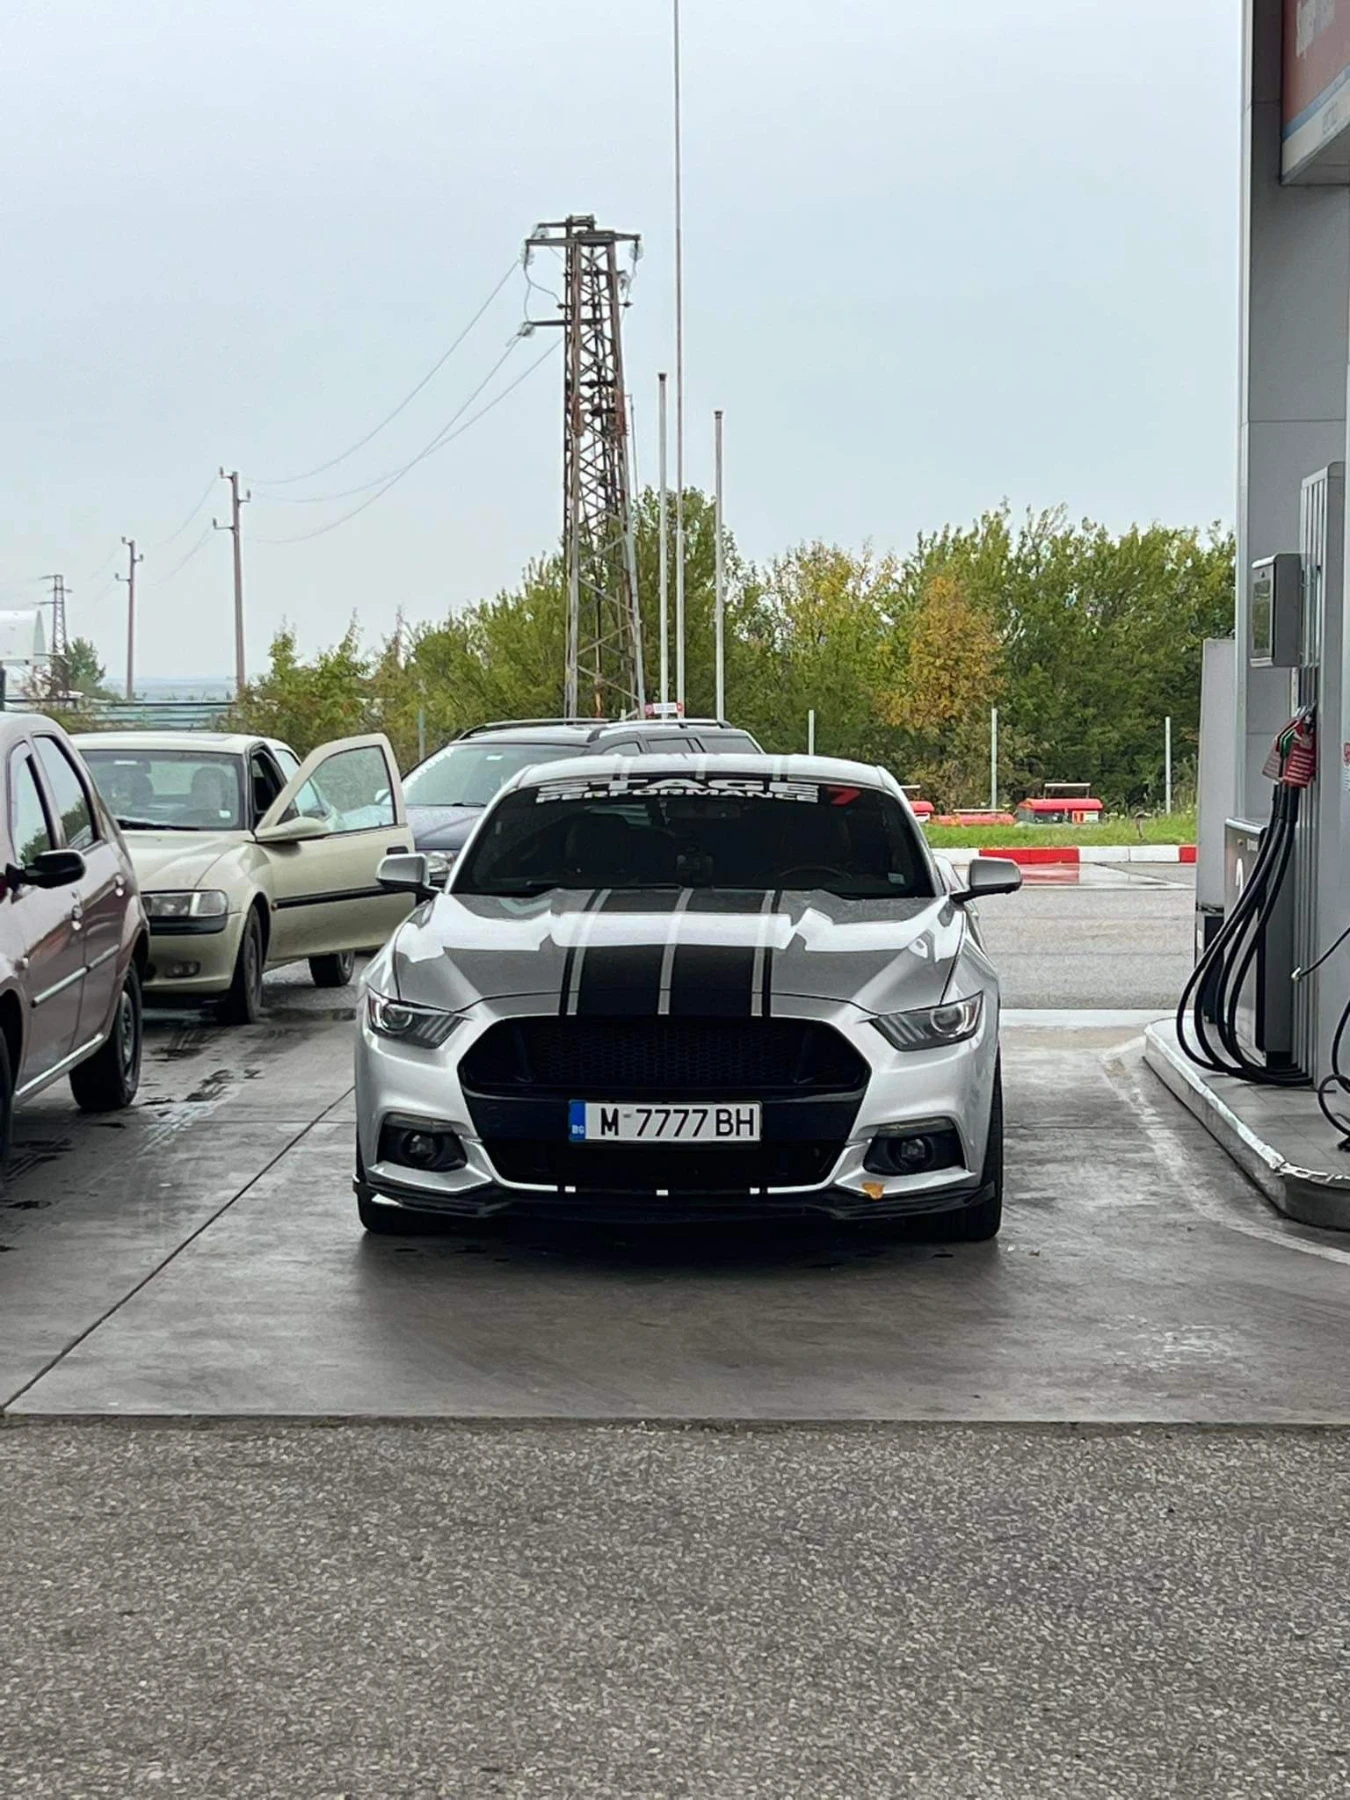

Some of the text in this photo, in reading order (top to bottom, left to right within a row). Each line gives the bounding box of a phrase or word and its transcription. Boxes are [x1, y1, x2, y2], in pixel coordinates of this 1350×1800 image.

[535, 788, 820, 804] PERFORMANCE
[537, 778, 861, 806] STAGE 7
[571, 1125, 585, 1135] BG
[635, 1108, 709, 1137] 7777
[715, 1107, 755, 1137] BH
